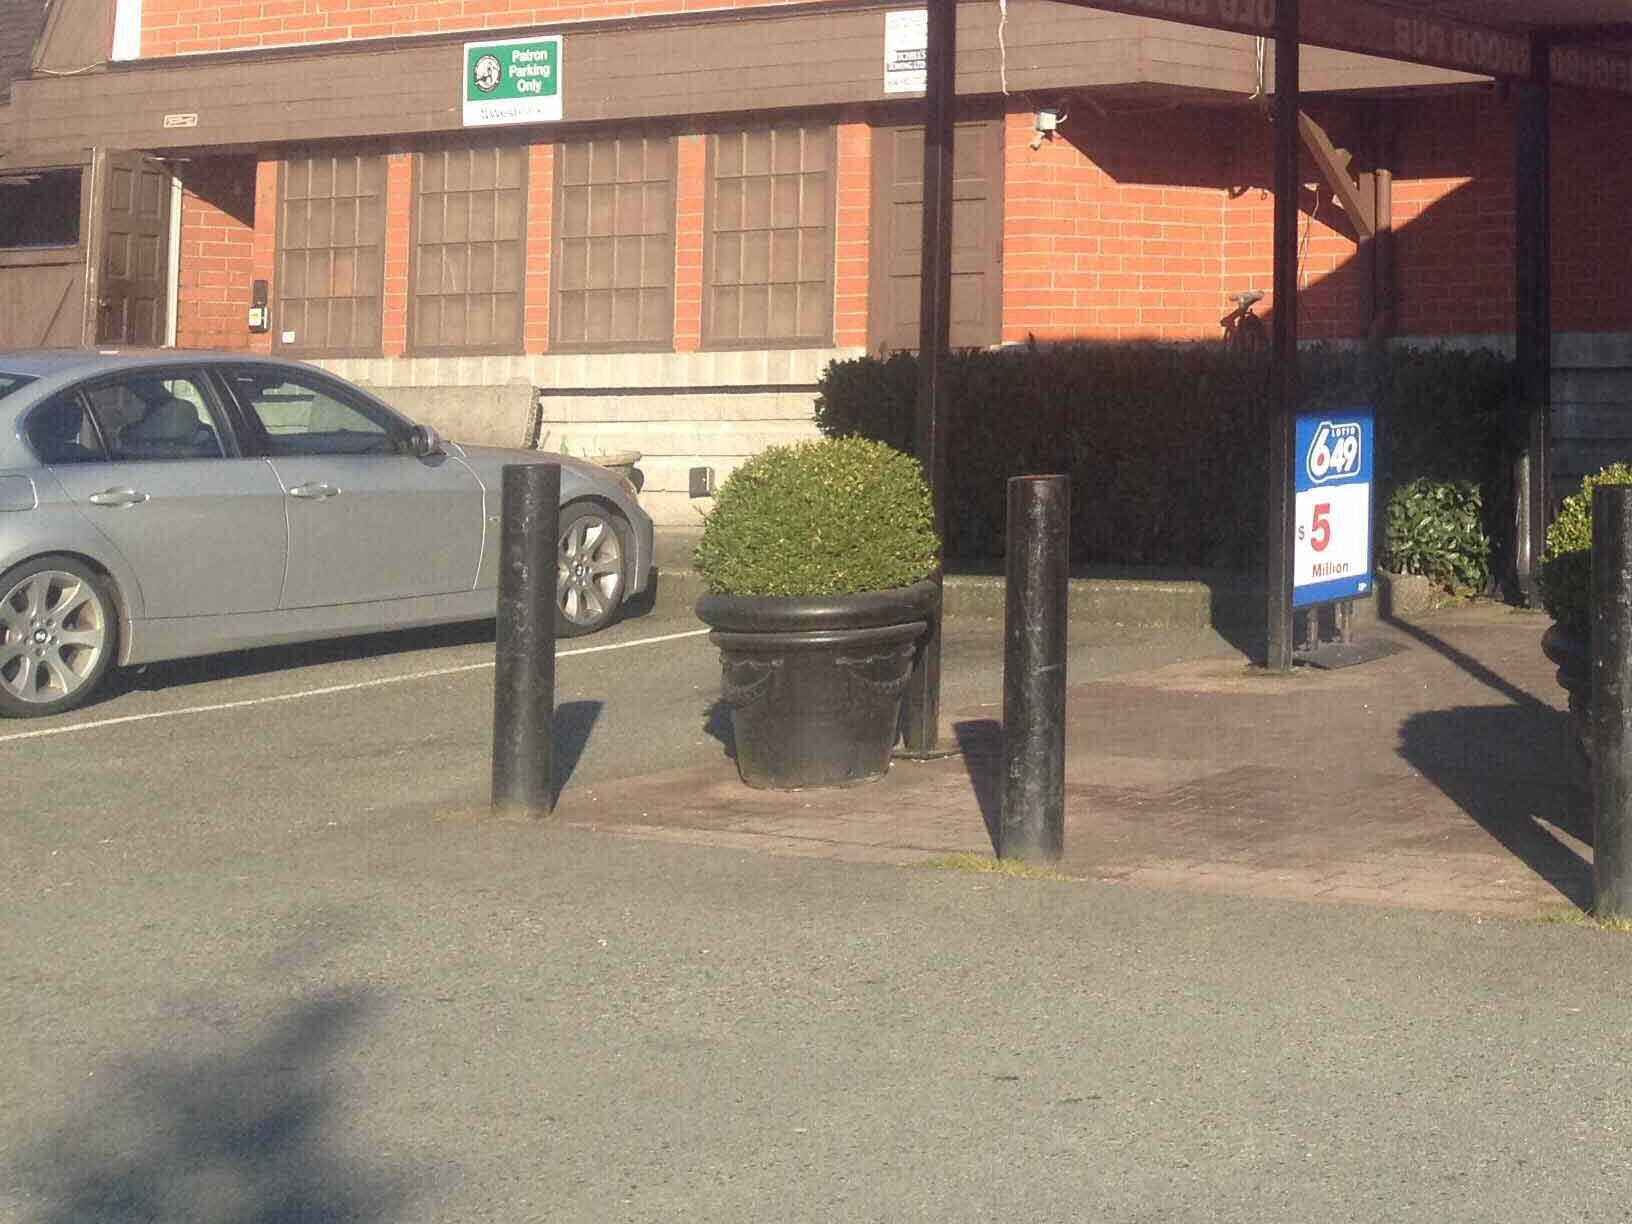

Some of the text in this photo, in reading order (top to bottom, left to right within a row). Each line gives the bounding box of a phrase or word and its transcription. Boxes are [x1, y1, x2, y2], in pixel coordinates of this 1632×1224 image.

[511, 49, 548, 63] Patron
[508, 63, 551, 78] Parking
[516, 78, 542, 93] Only
[1331, 426, 1356, 438] LOTTO
[1310, 503, 1331, 552] 5
[1311, 559, 1349, 577] Million
